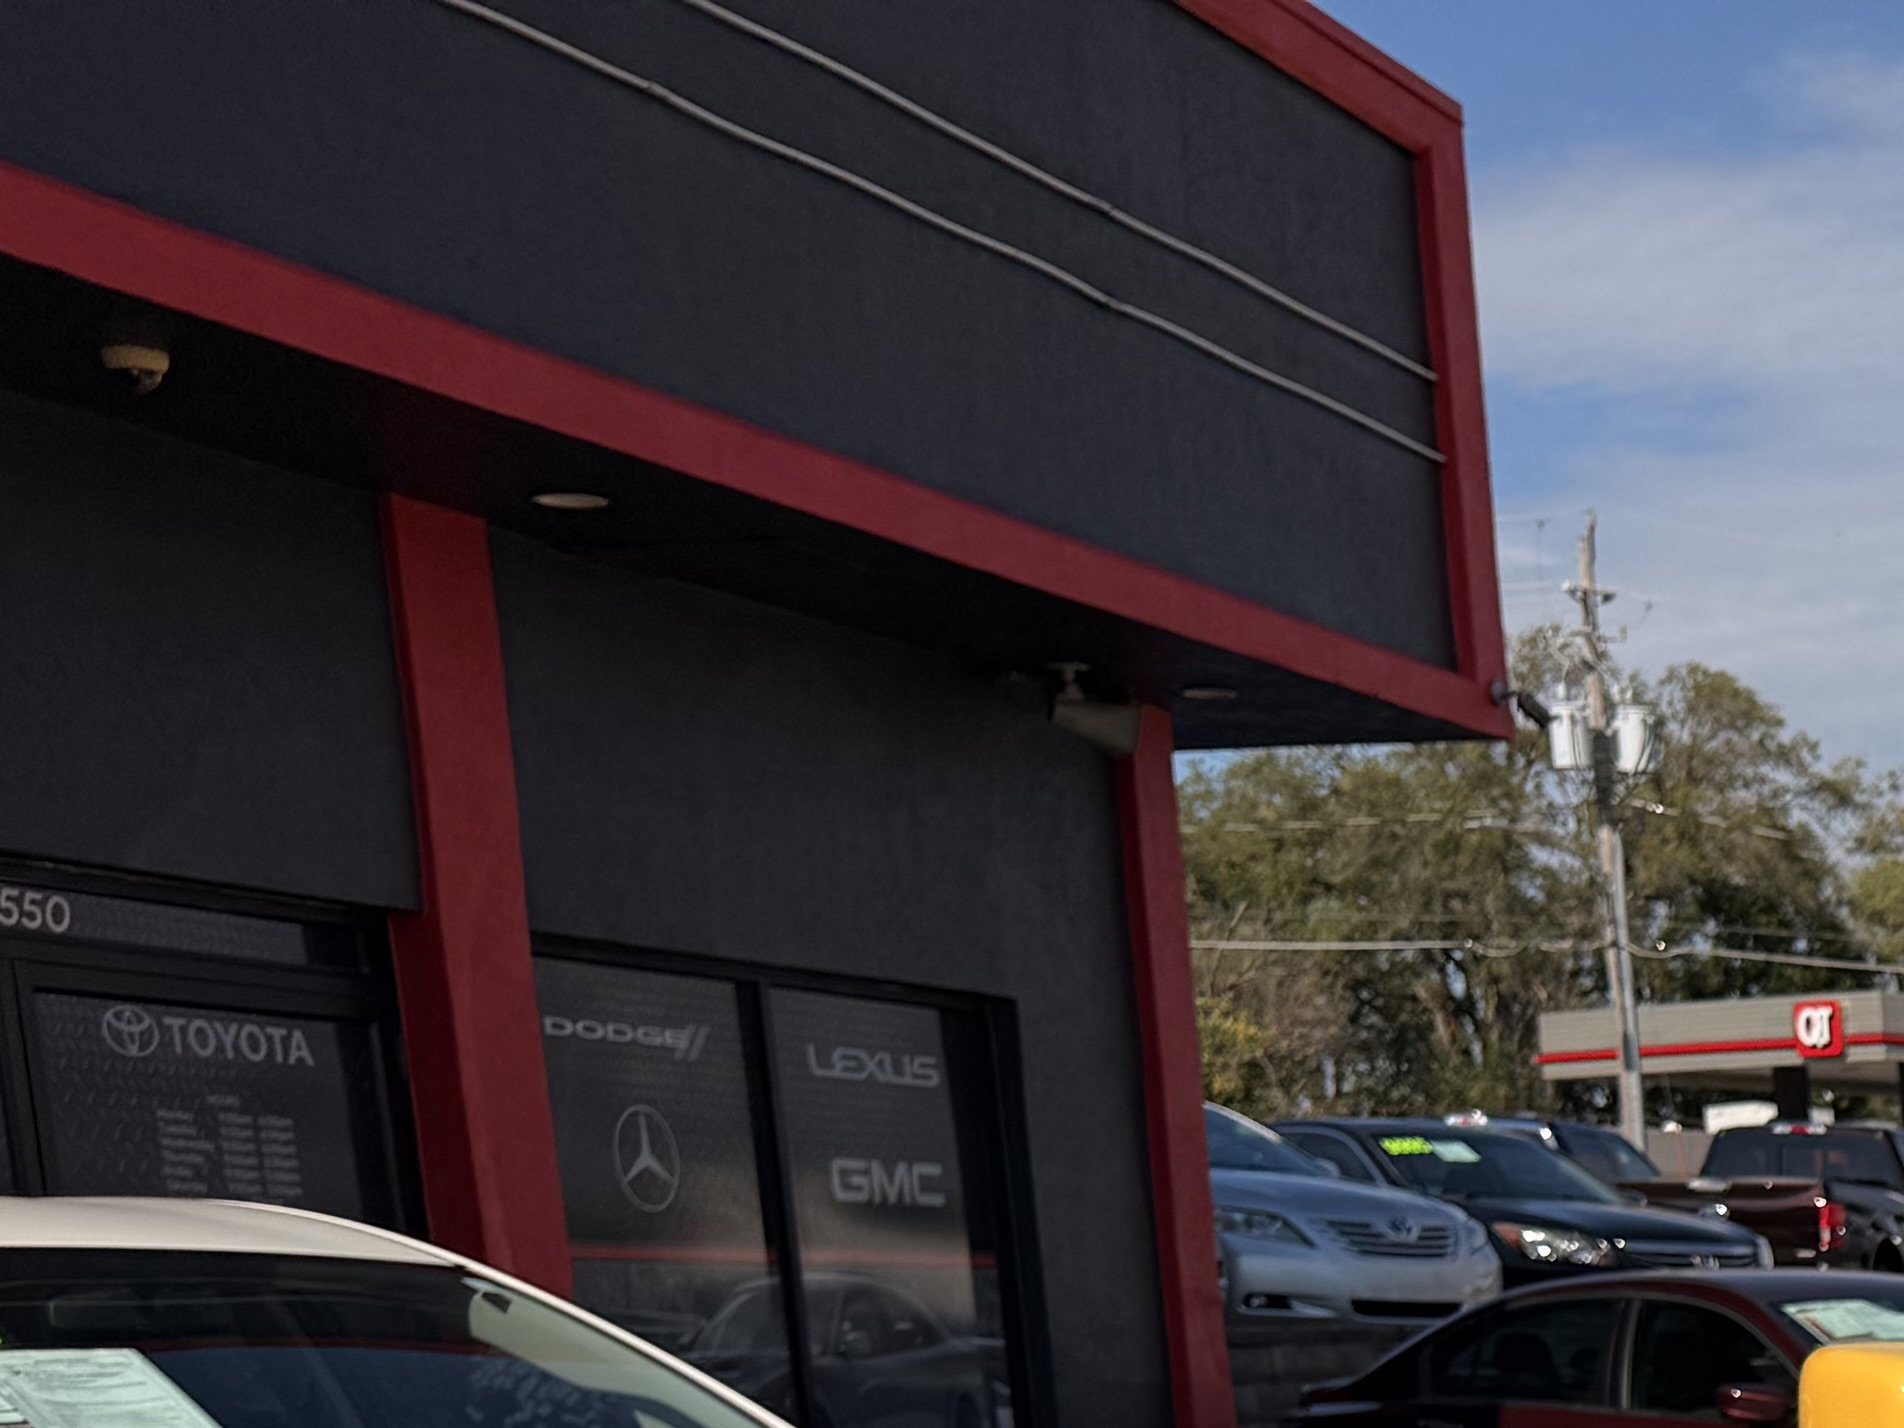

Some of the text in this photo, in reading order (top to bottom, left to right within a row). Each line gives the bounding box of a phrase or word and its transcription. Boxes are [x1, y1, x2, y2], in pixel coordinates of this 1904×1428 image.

[162, 1016, 314, 1066] TOYOTA
[543, 1015, 692, 1050] DODGE
[806, 1043, 941, 1088] LEXUS
[832, 1157, 946, 1208] GMC
